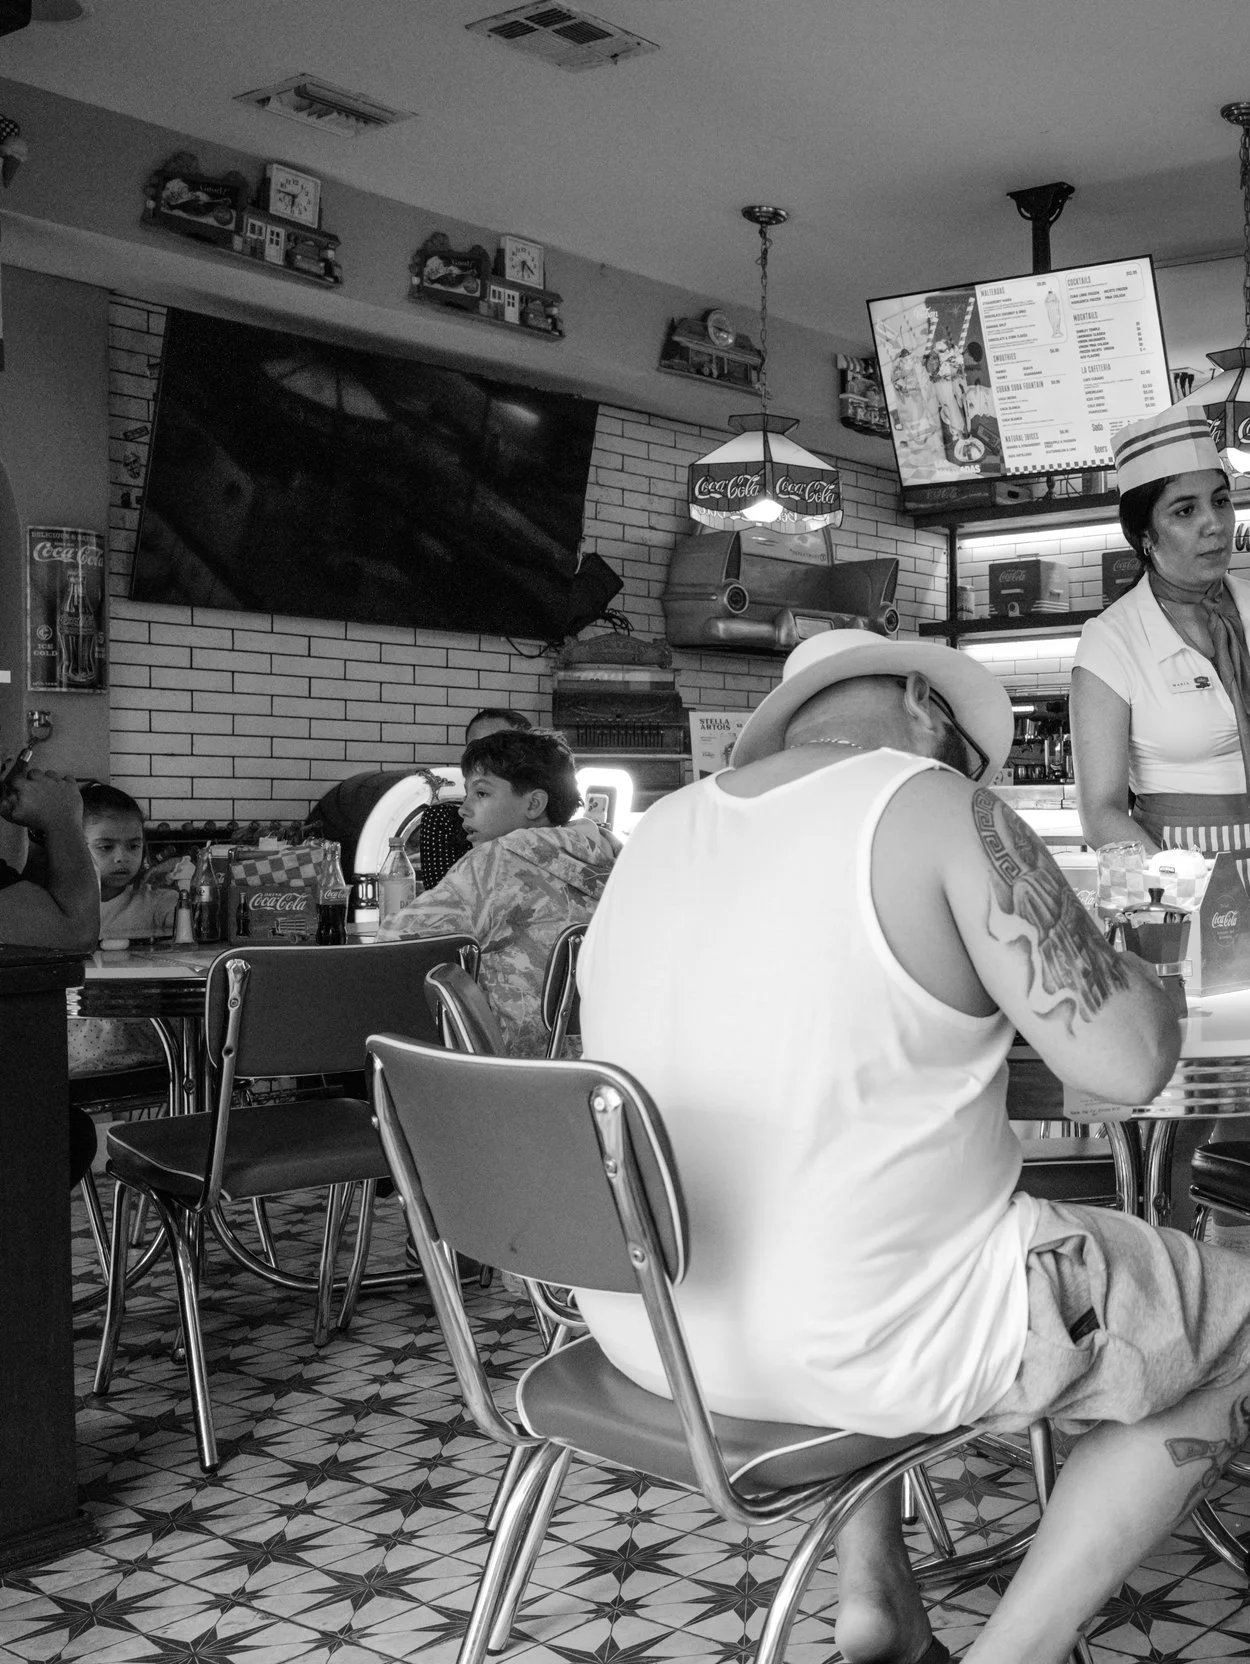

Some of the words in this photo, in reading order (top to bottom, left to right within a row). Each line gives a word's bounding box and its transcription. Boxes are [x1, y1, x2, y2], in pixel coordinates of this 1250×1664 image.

[1068, 275, 1091, 286] COCKTAILS
[695, 475, 761, 499] Coca-Cola
[776, 475, 836, 504] Coca-Cola
[33, 541, 104, 567] Coca-Cola
[249, 892, 309, 911] Coca-Cola
[1212, 910, 1238, 928] Coca-Cola
